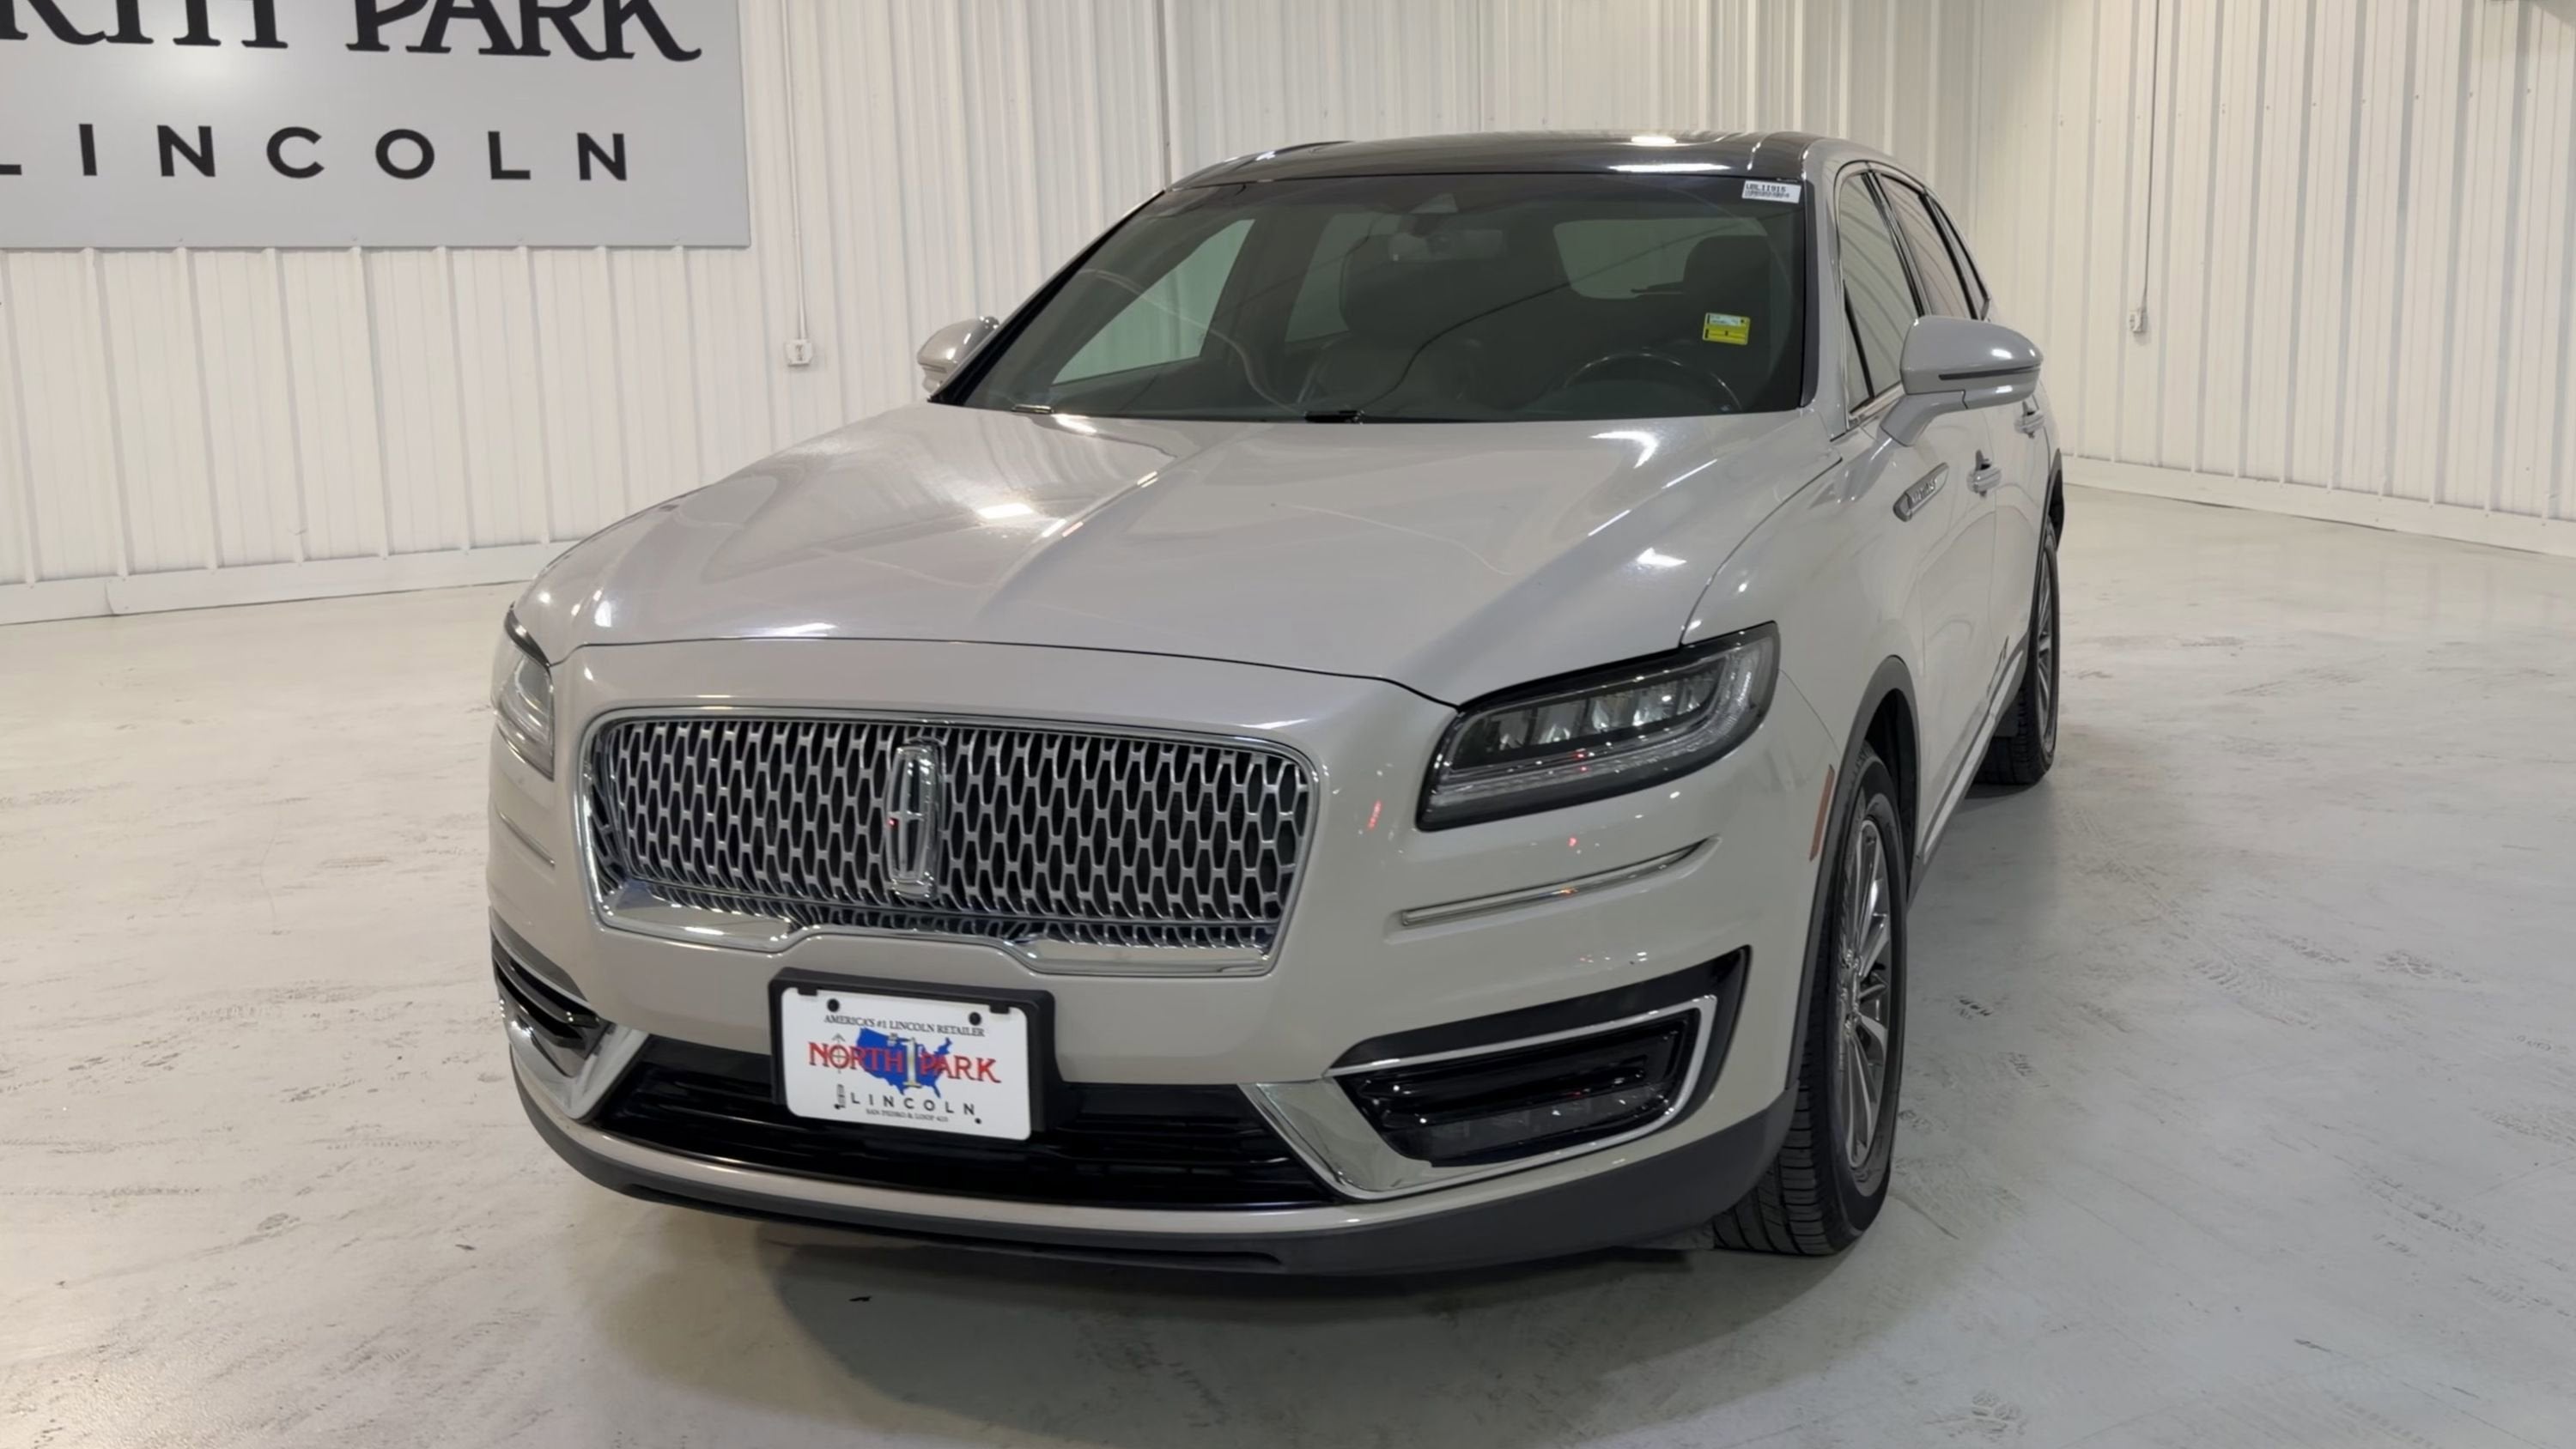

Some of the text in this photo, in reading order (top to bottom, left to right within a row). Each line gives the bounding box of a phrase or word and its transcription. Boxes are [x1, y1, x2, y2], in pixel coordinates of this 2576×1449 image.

[0, 124, 627, 181] INCOLN
[823, 1015, 875, 1028] AMERICA'S
[889, 1020, 935, 1033] LINCOLN
[937, 1024, 985, 1037] RETAILER
[808, 1041, 1002, 1083] NORTH PARK
[851, 1092, 975, 1116] LINCOLN
